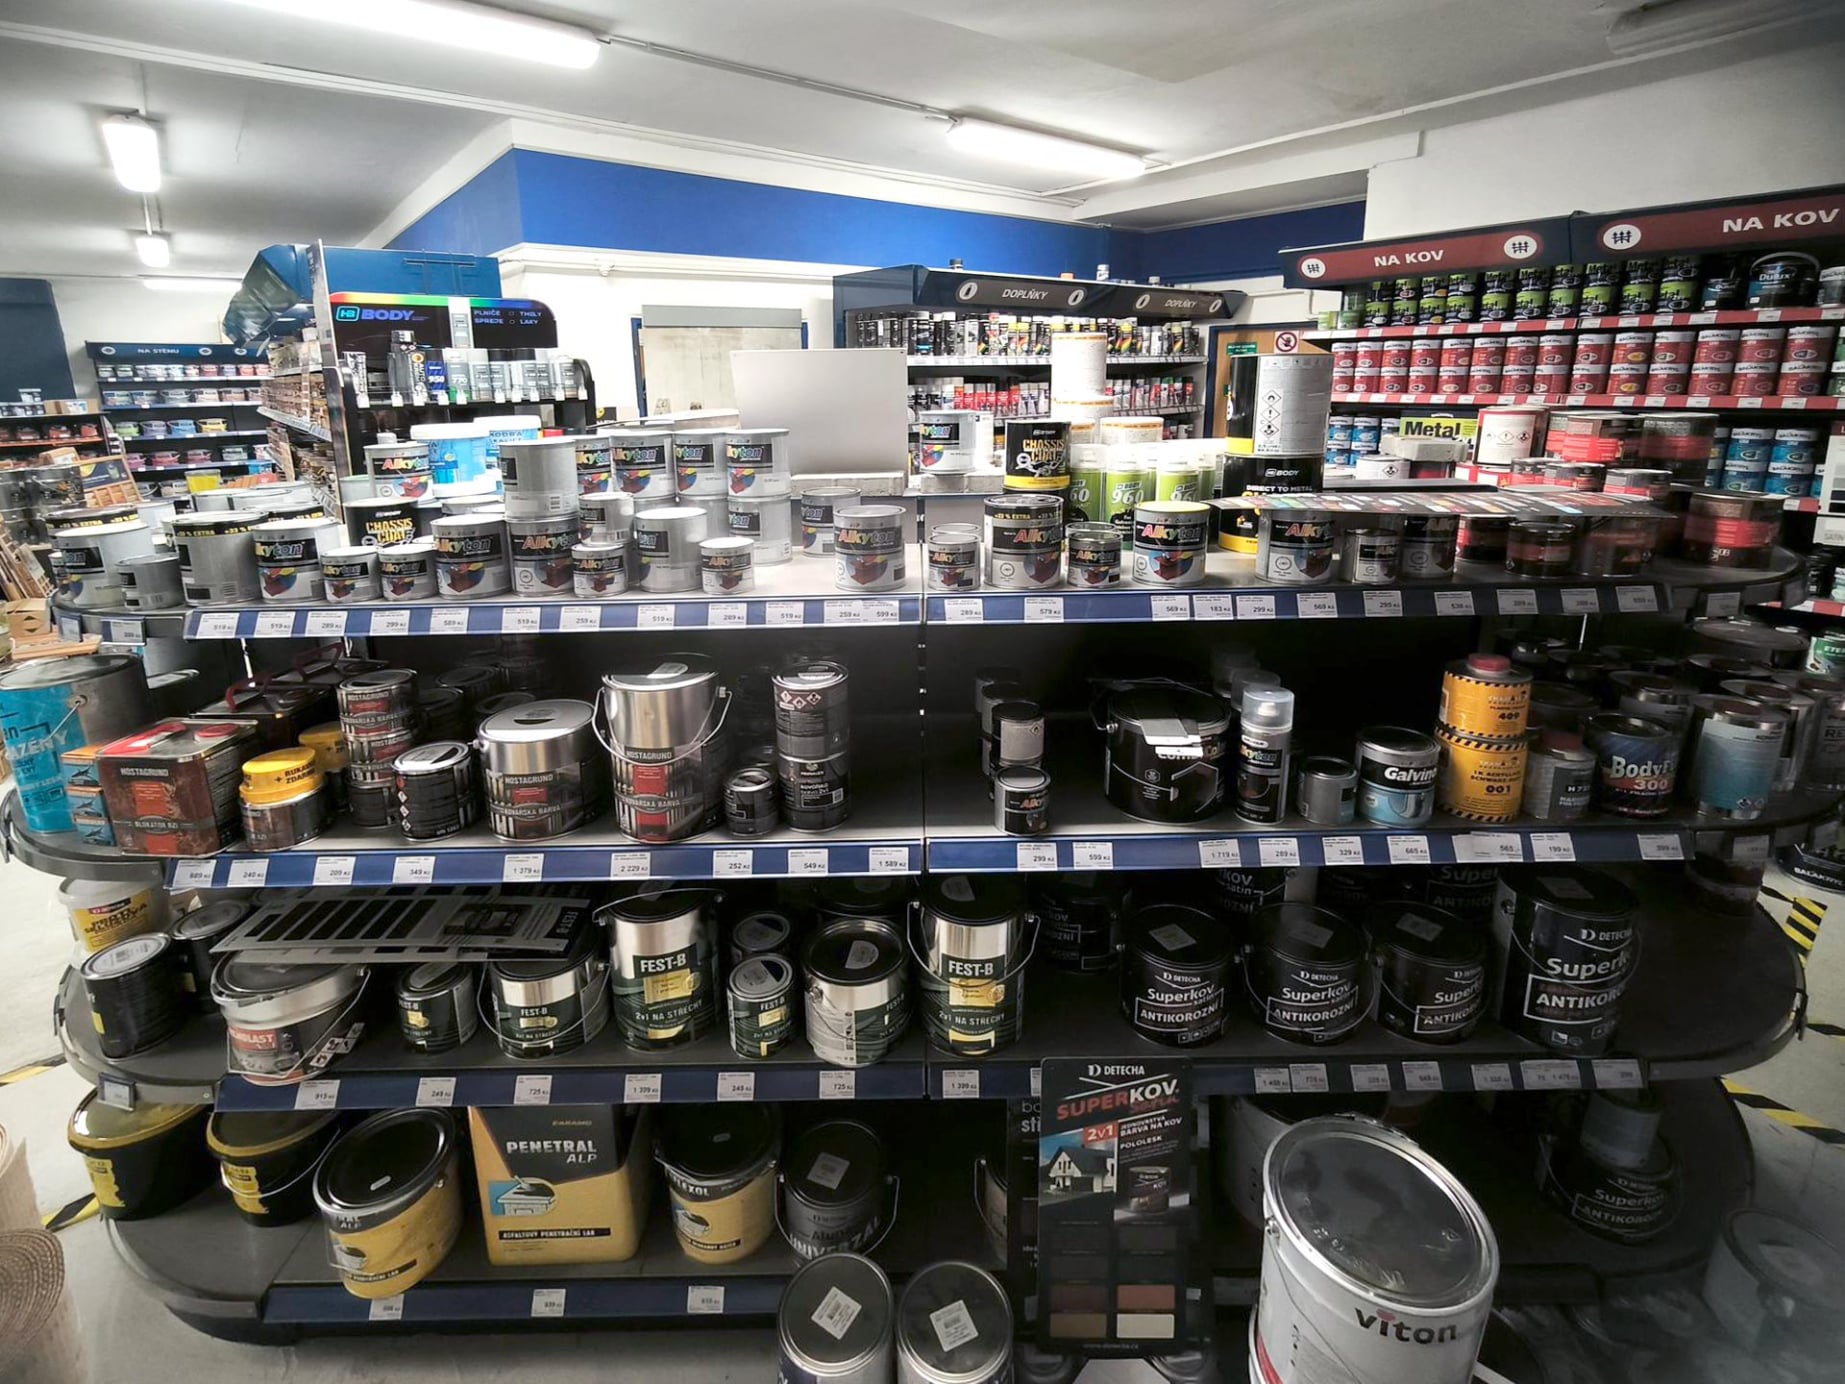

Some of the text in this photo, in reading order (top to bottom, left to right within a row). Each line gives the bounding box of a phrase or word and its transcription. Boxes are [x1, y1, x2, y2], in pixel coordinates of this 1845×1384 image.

[1722, 208, 1840, 233] NA KOV
[1373, 250, 1445, 267] NA KOV
[1759, 272, 1794, 281] Dulux
[1002, 287, 1048, 300] DOPLŇKY
[1164, 298, 1197, 309] DOPLŇKY
[361, 308, 415, 321] BODY
[1404, 421, 1461, 438] Metal
[1022, 438, 1065, 451] CHASSIS
[1276, 469, 1300, 477] BODY
[1246, 484, 1276, 492] DIRECT
[1111, 489, 1144, 504] 960
[366, 517, 413, 532] CHASSIS
[838, 528, 894, 545] Alkyton
[1141, 524, 1201, 540] Alkyton
[1498, 711, 1520, 721] 409
[625, 750, 672, 760] HOSTAGRUND
[119, 767, 169, 777] HOSTAGRUND
[505, 774, 554, 785] HOSTAGRUND
[1633, 778, 1668, 791] 300
[1485, 784, 1511, 794] 001
[640, 953, 687, 973] FEST-B
[948, 960, 994, 976] FEST-B
[1147, 984, 1216, 1005] Superkov
[760, 997, 785, 1011] FEST-B
[521, 1007, 548, 1016] FEST-B
[652, 1011, 665, 1021] NA
[1140, 1003, 1219, 1023] ANTIKOROZNÍ
[1274, 1000, 1356, 1022] ANTIKOROZNÍ
[954, 1015, 966, 1024] NA
[1103, 1065, 1145, 1075] DETECHA
[1087, 1124, 1114, 1141] 2v1
[1120, 1117, 1183, 1137] BARVA NA KOV
[506, 1139, 598, 1154] PENETRAL
[1120, 1135, 1163, 1150] POLOLESK
[566, 1153, 598, 1164] ALP
[1354, 1306, 1458, 1344] viton
